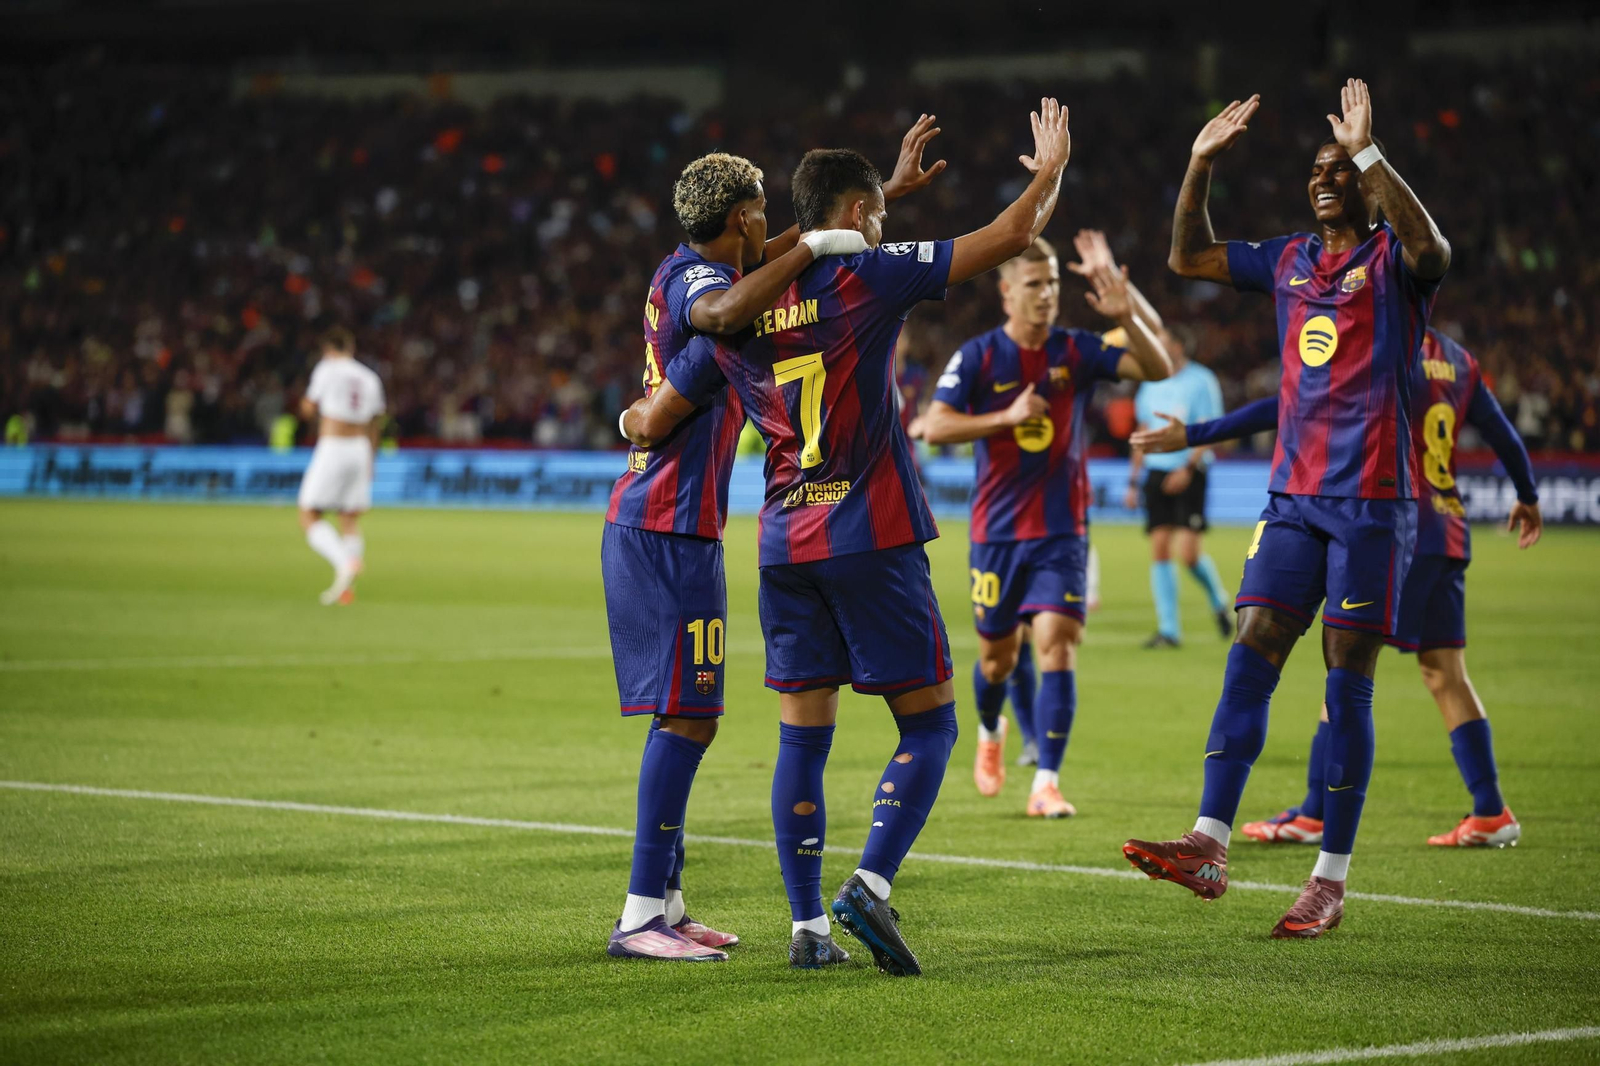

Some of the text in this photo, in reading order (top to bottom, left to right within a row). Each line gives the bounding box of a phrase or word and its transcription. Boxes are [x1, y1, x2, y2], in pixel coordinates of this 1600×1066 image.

[754, 298, 819, 337] FERRAN
[772, 351, 827, 470] 7
[1423, 402, 1456, 490] 8
[805, 481, 851, 492] UNHCR
[970, 566, 1001, 608] 20
[687, 617, 724, 665] 10
